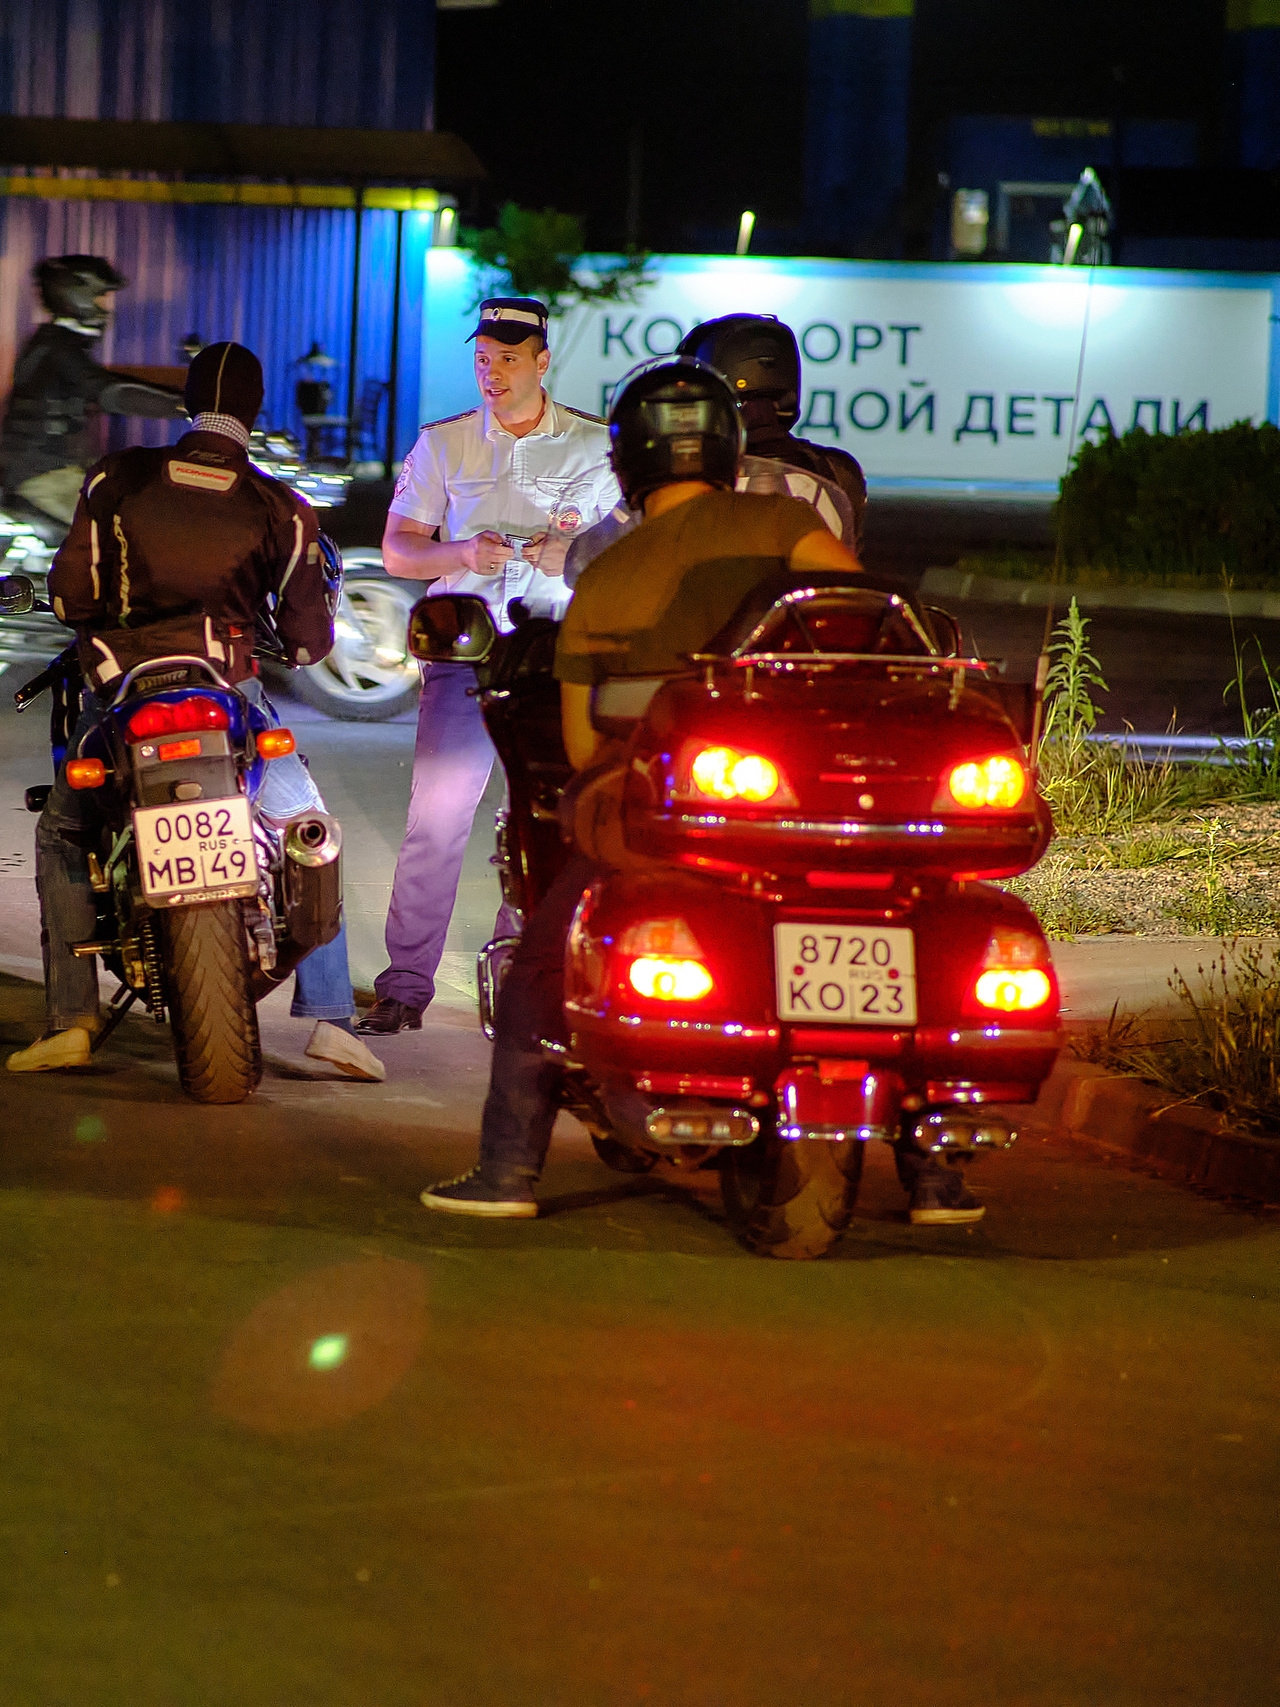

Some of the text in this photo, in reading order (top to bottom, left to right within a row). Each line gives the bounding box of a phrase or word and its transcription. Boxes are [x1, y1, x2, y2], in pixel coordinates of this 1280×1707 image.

[603, 315, 922, 365] КООРТ
[954, 394, 1208, 443] ДЕТАЛИ
[155, 809, 233, 843] 0082
[199, 839, 227, 852] RUS
[212, 850, 246, 879] 49
[800, 935, 891, 966] 8720
[861, 984, 903, 1014] 23
